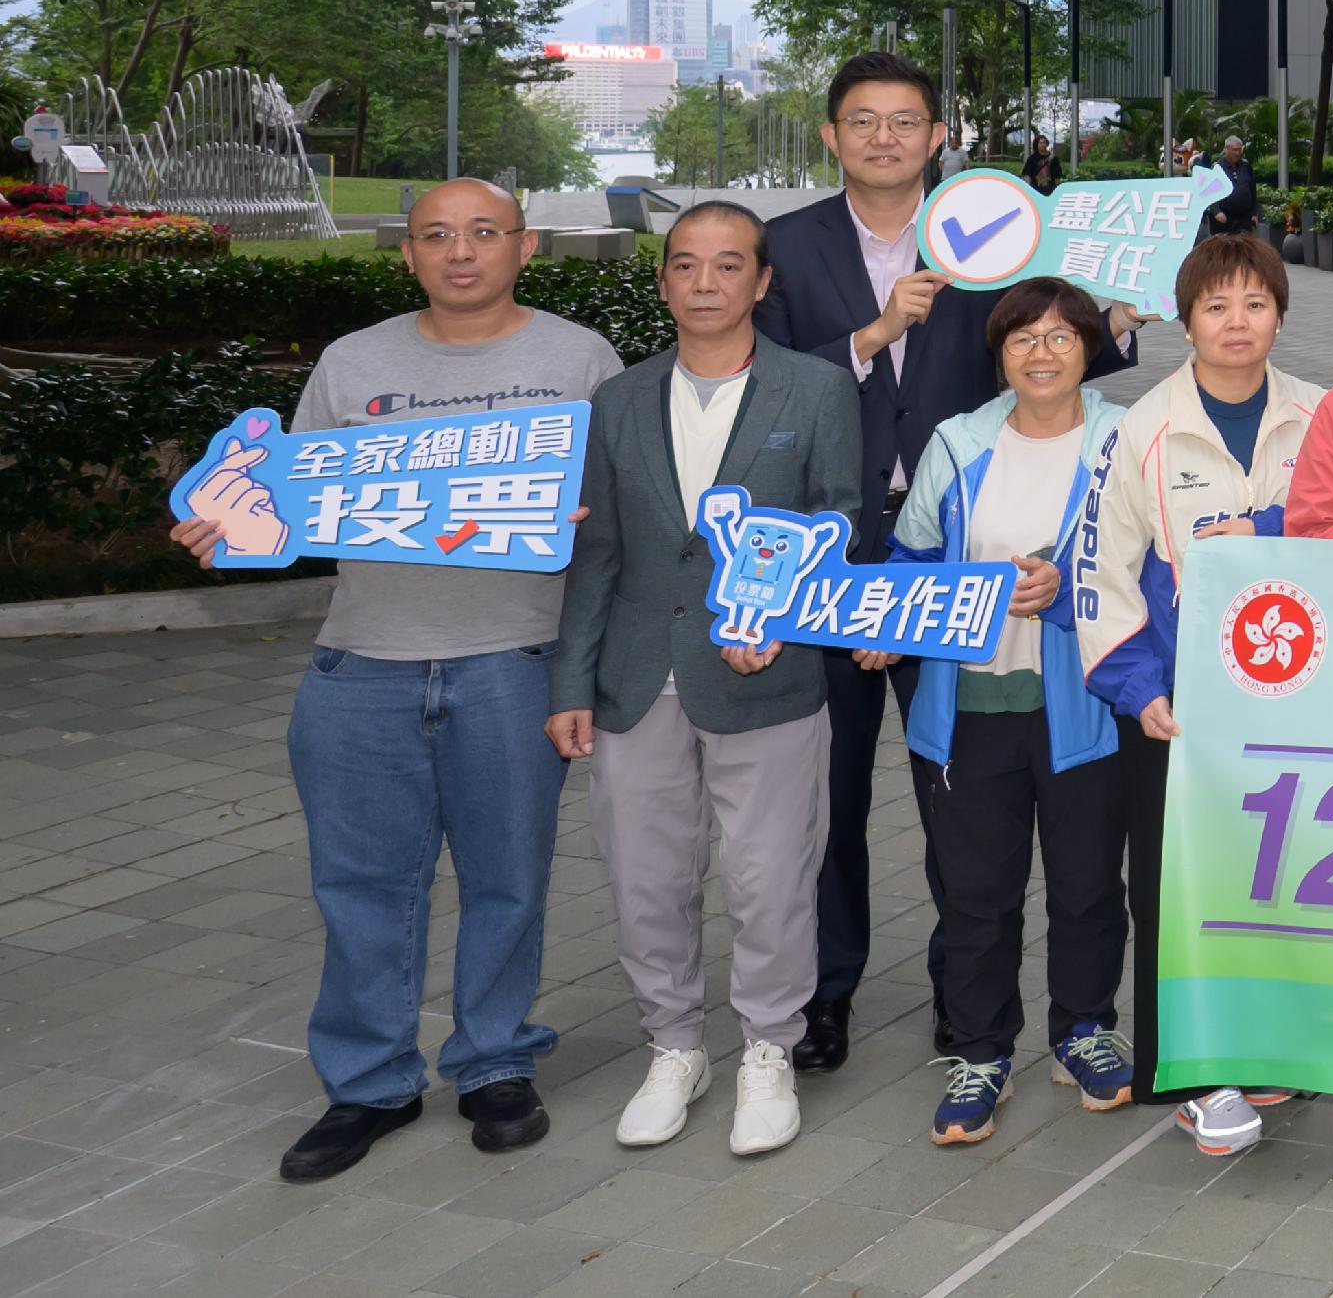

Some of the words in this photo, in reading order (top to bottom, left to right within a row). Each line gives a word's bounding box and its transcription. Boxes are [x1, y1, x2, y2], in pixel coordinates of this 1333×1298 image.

[562, 46, 632, 59] PRUDENTIAL
[1048, 191, 1192, 239] 盡公民
[1057, 238, 1156, 293] 責任
[366, 386, 564, 416] Champion
[287, 415, 574, 479] 全家總動員
[305, 472, 566, 556] 投票
[796, 575, 1003, 647] 以身作則
